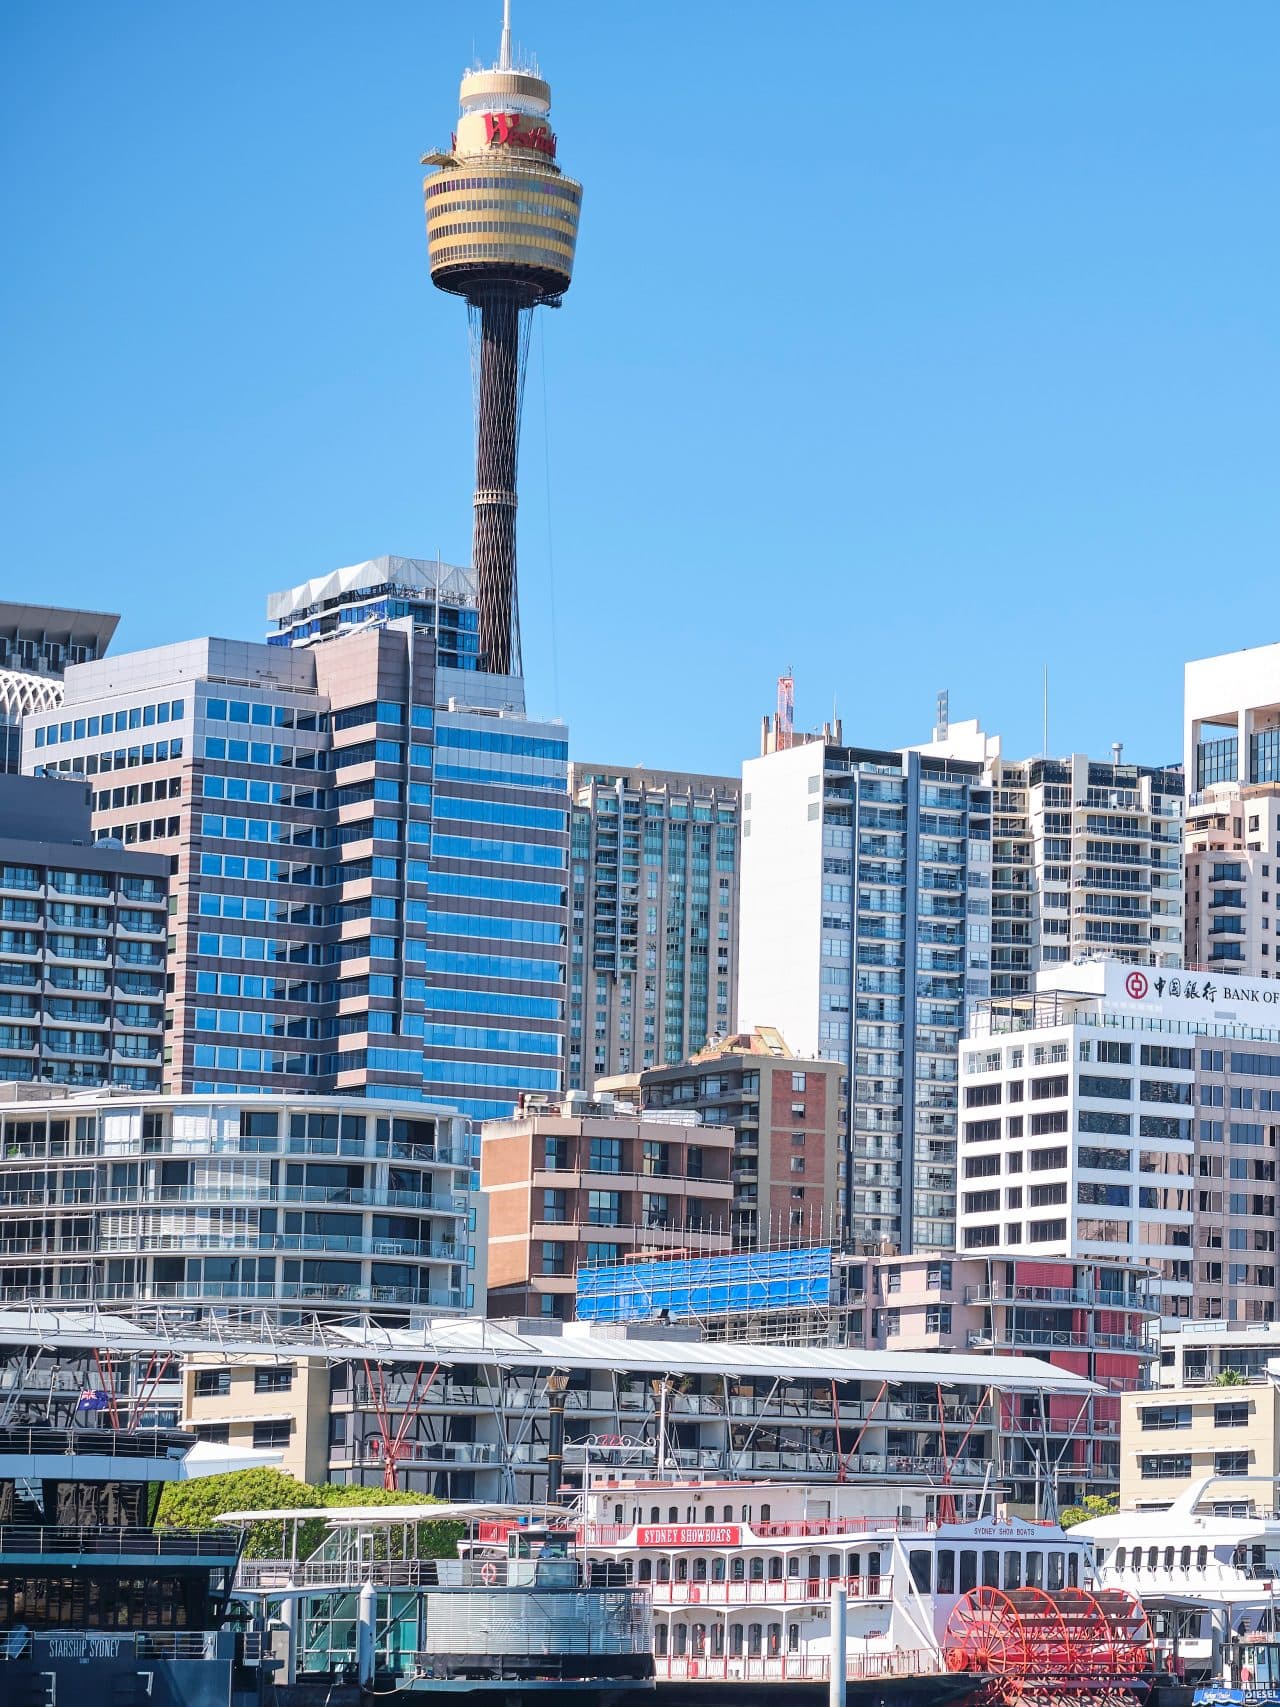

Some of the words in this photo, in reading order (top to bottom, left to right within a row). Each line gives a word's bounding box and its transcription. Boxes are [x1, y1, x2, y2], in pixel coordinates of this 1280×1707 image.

[481, 112, 557, 158] Westfi
[1223, 987, 1260, 1003] BANK
[1262, 991, 1280, 1004] OF
[644, 1529, 678, 1543] SYDNEY
[680, 1528, 731, 1543] SHOWBOATS
[974, 1527, 996, 1535] SYDNEY
[1016, 1528, 1035, 1536] BOATS
[49, 1639, 87, 1657] STARSHIP
[89, 1639, 120, 1657] SYDNEY
[1245, 1690, 1278, 1699] DIESEL
